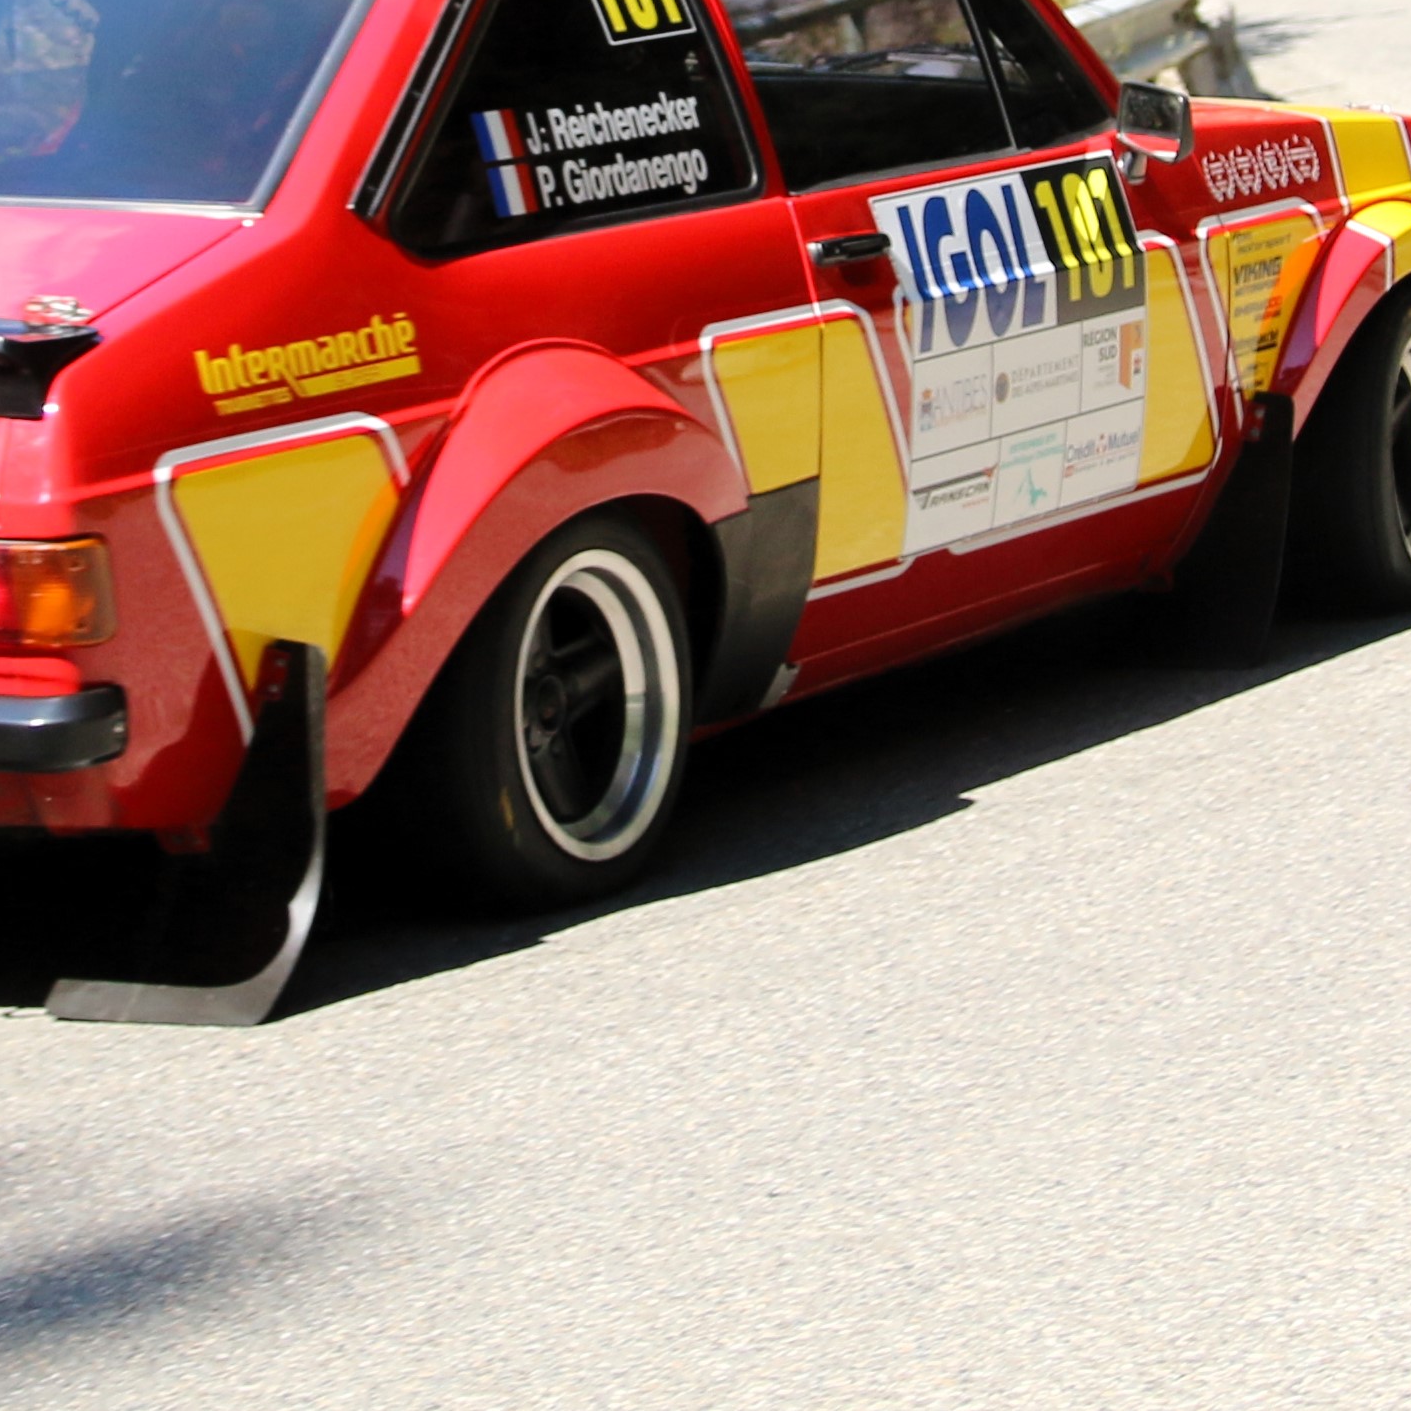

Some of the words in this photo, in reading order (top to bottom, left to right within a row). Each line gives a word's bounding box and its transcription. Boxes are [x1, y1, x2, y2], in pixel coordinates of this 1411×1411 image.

[546, 91, 700, 151] Reichenecker
[535, 165, 564, 208] P.
[562, 149, 708, 204] Giordanengo
[896, 184, 1047, 353] IGOL
[1034, 167, 1136, 302] 101
[1233, 256, 1283, 284] VIKING
[194, 312, 418, 396] Intermarché
[1098, 344, 1119, 363] SUD
